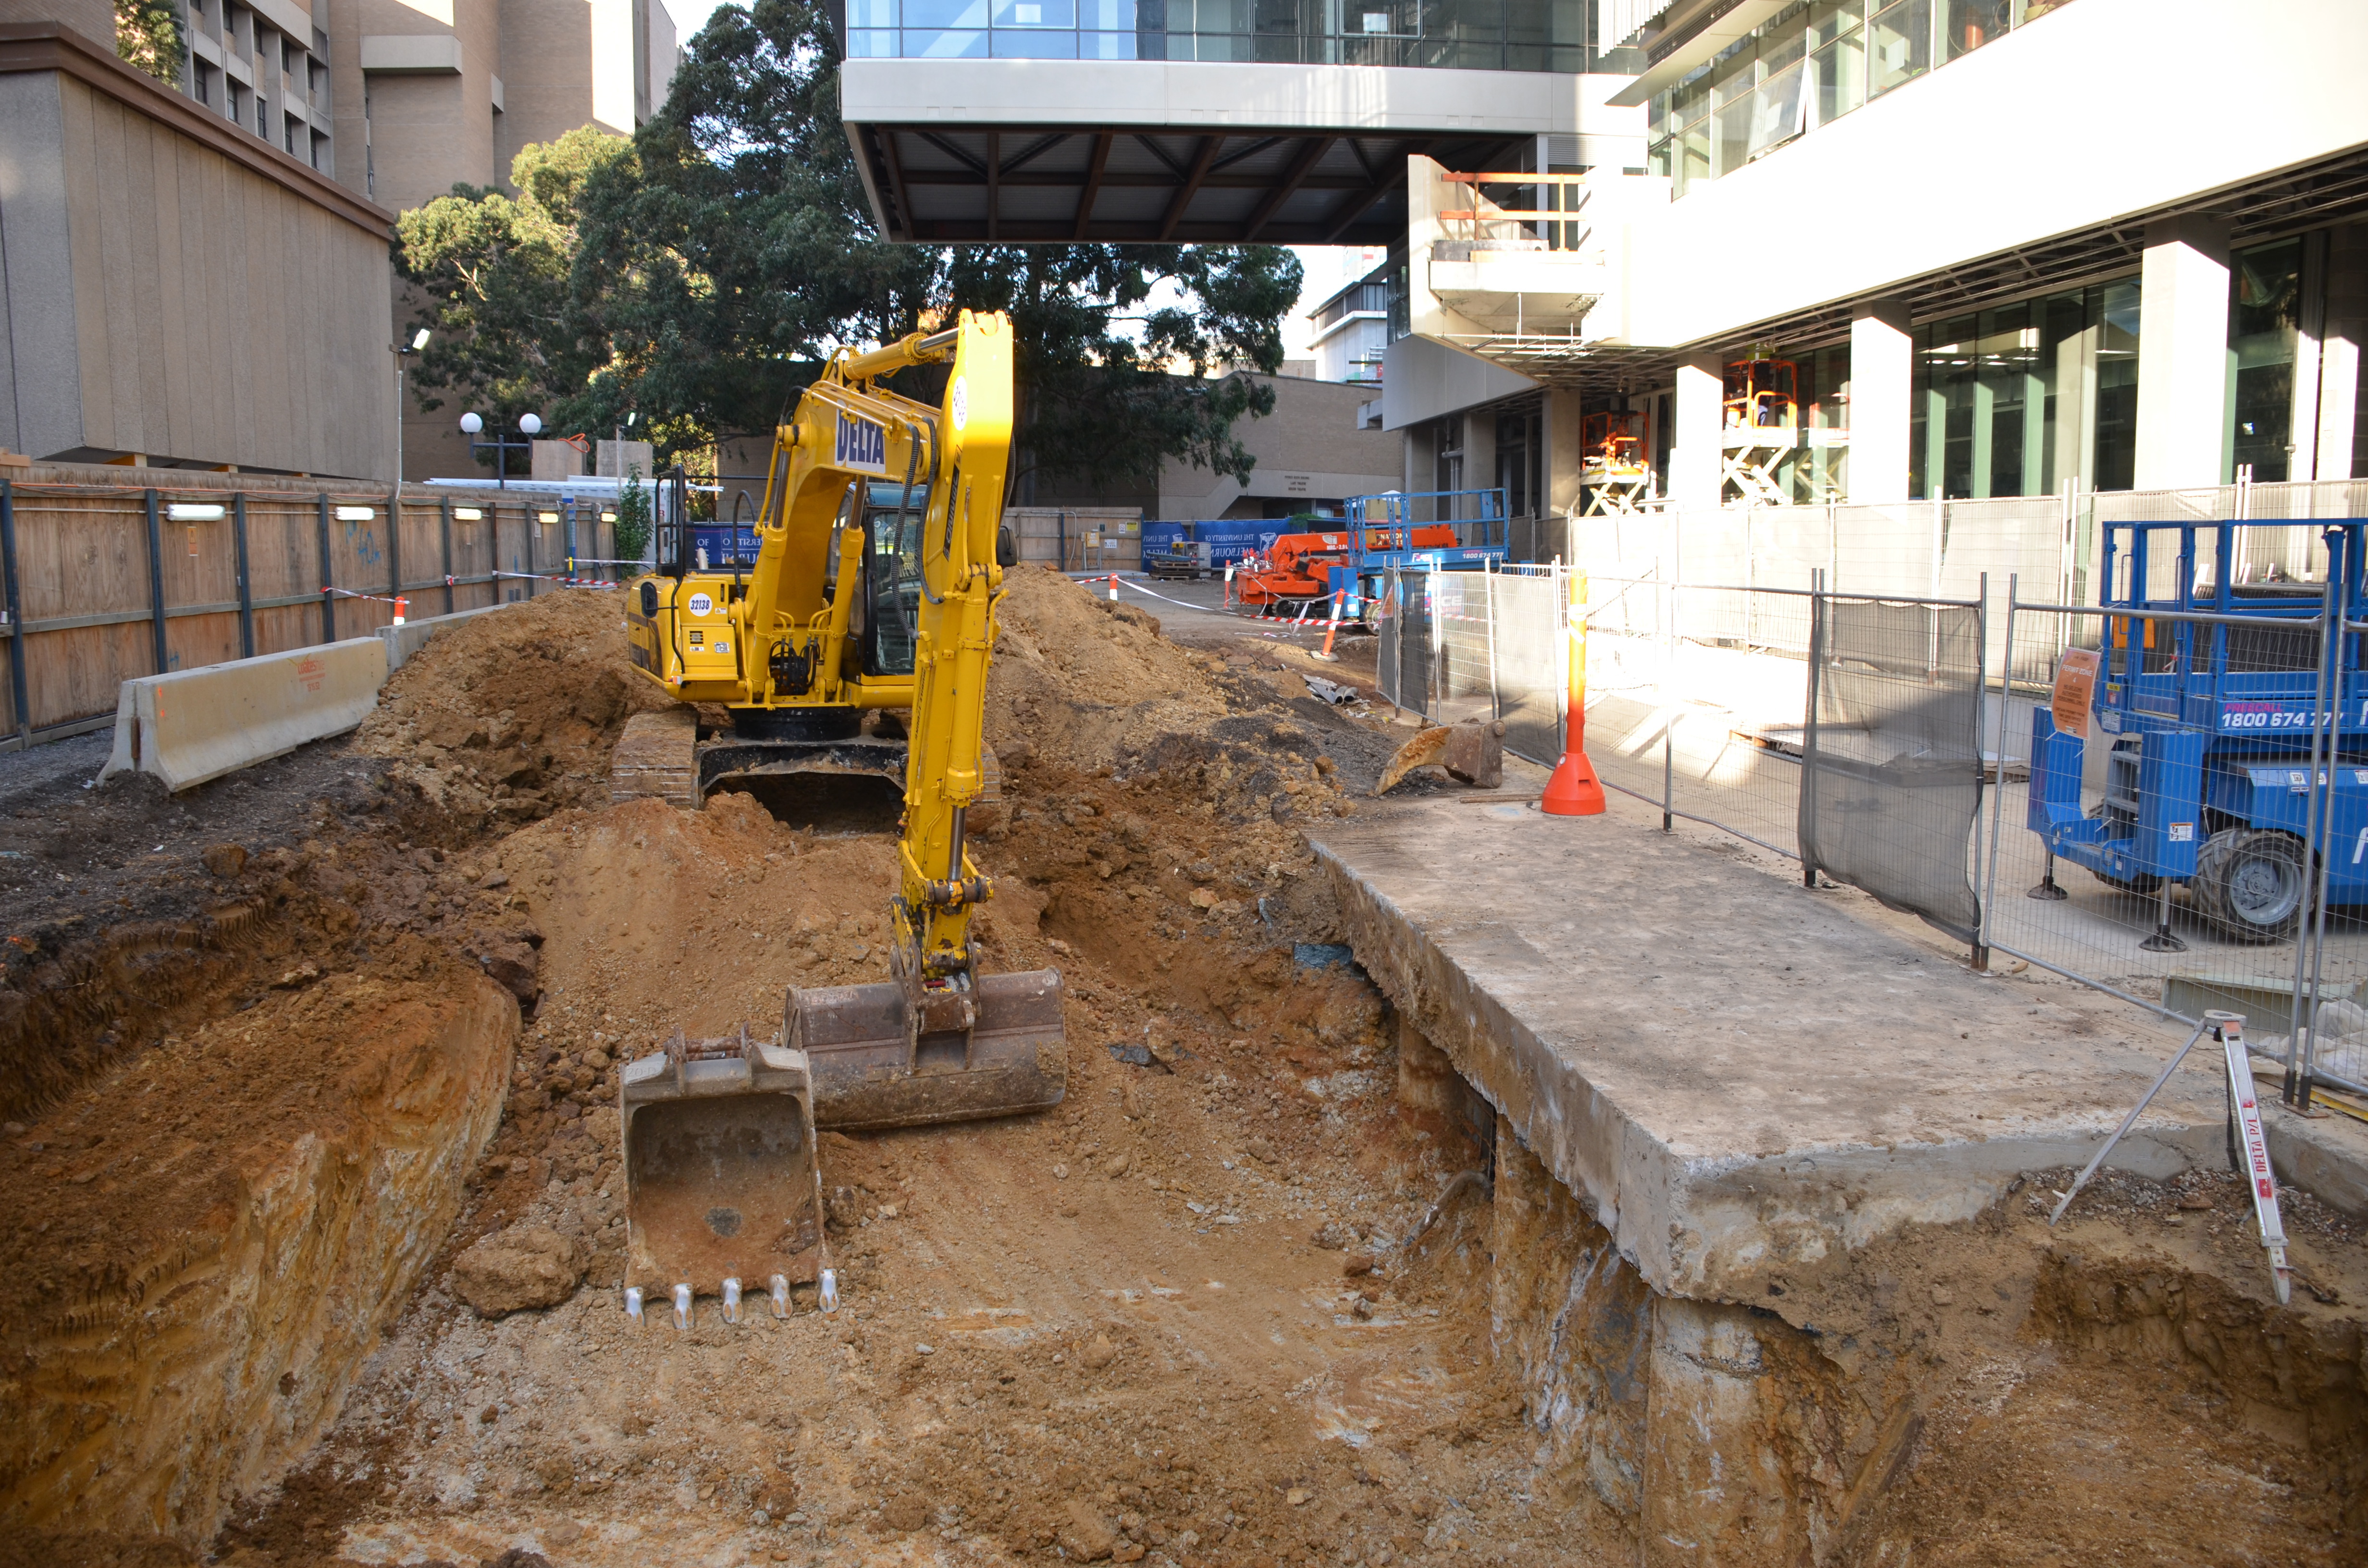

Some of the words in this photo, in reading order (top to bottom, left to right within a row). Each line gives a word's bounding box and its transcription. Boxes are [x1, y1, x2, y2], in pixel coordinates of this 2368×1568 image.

[837, 408, 885, 465] DELTA
[691, 600, 710, 610] 32138
[2061, 664, 2079, 674] PERMIT
[2079, 668, 2093, 677] ZONE
[2224, 702, 2282, 713] FREECALL
[2222, 712, 2267, 727] 1800
[2270, 712, 2306, 726] 674
[2247, 1118, 2260, 1135] P/L
[2251, 1140, 2267, 1172] DELTA
